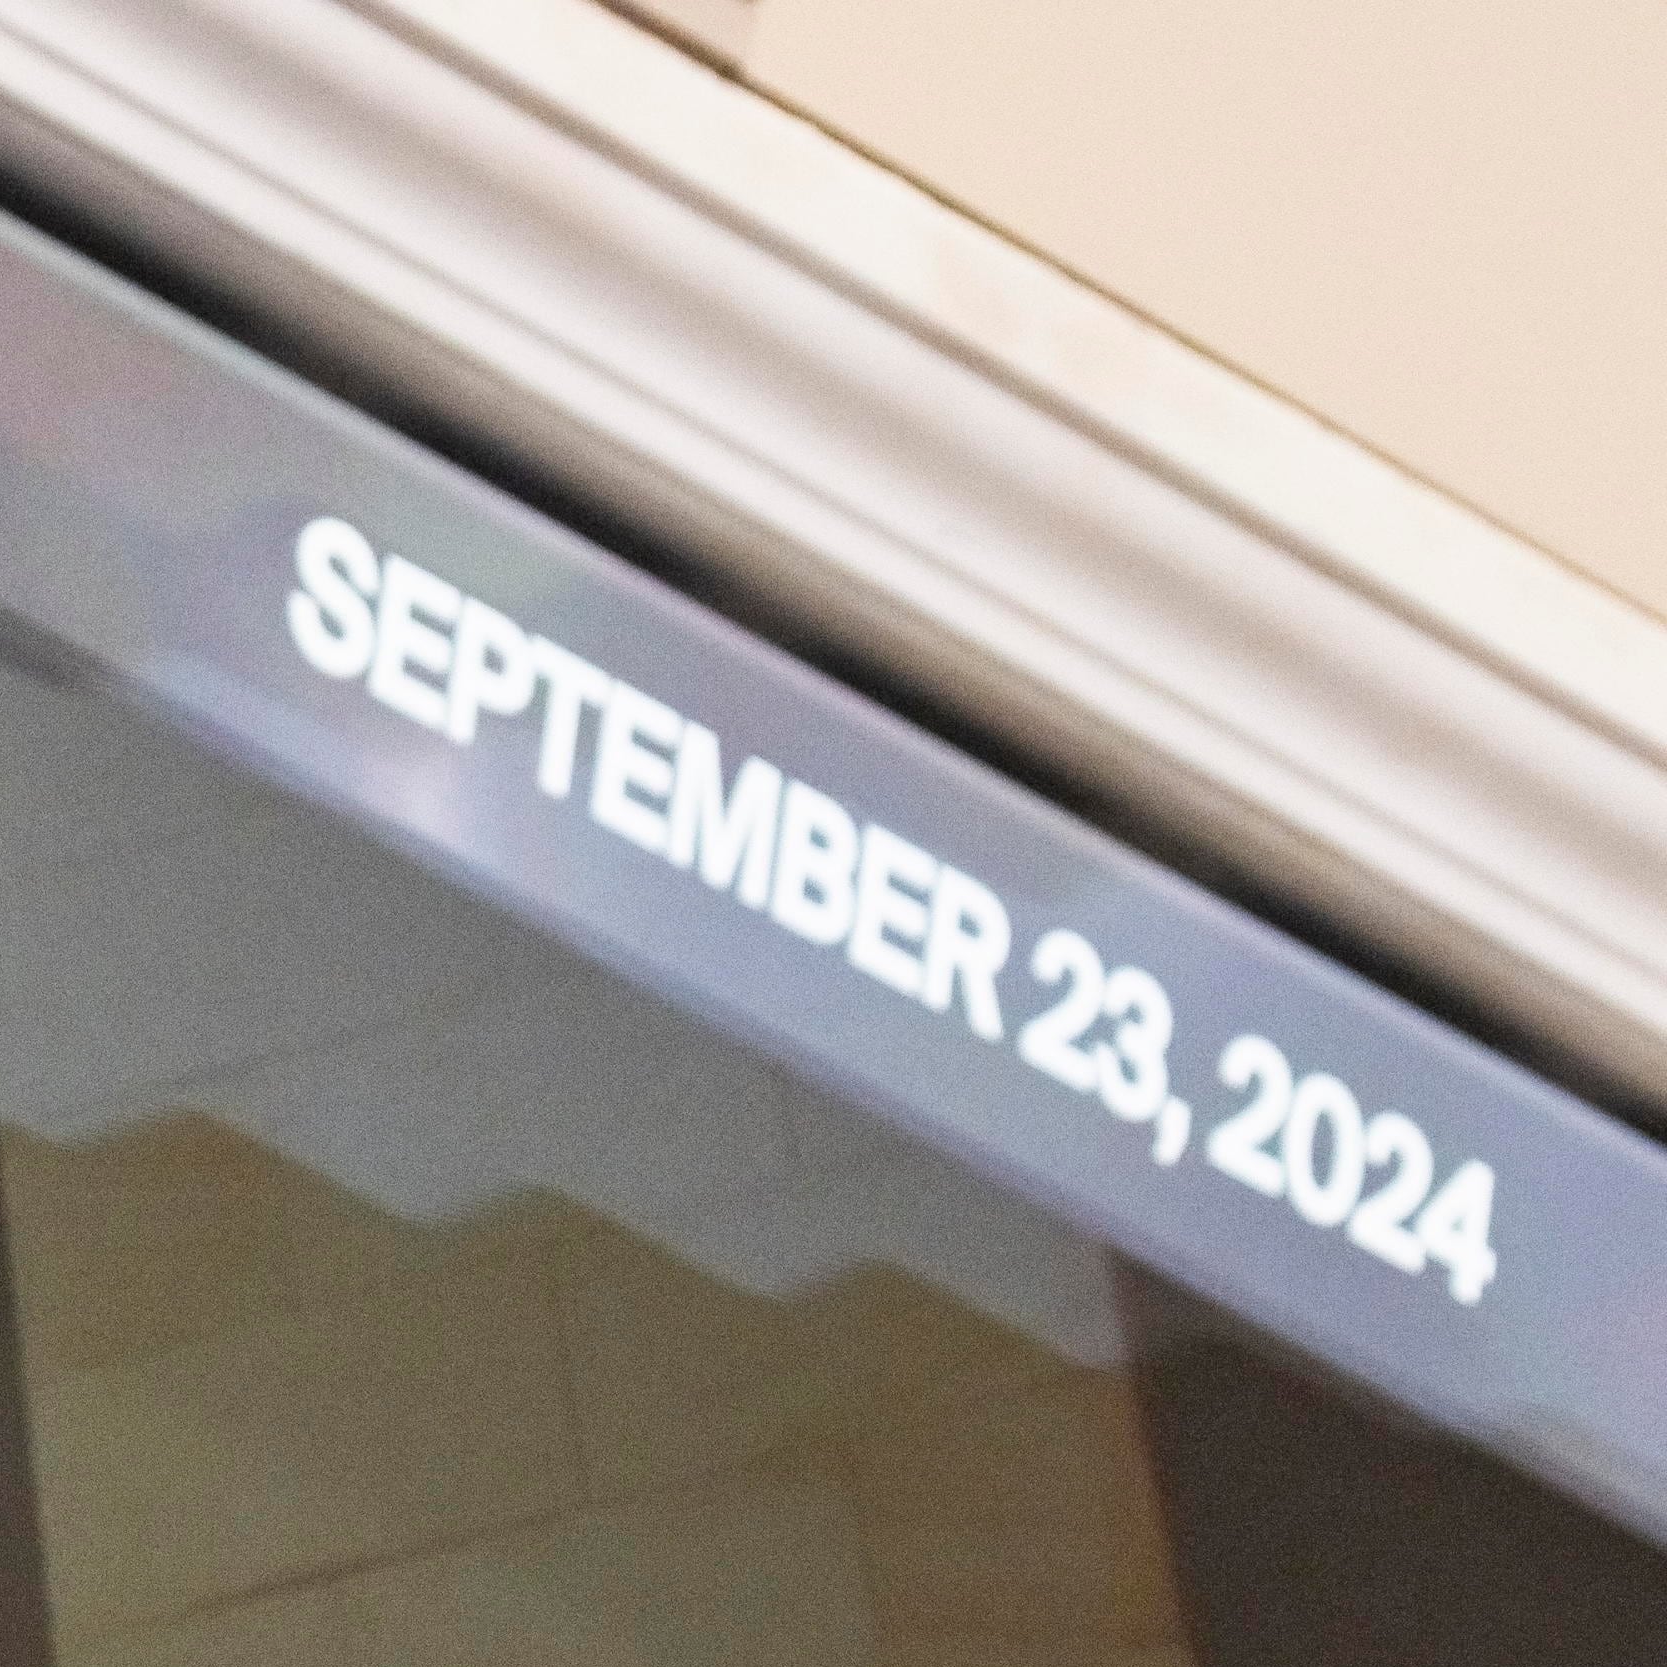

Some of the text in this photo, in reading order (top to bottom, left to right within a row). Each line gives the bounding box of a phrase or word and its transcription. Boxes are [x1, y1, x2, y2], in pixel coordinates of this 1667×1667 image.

[286, 515, 1499, 1305] SEPTEMBER 23, 2024
